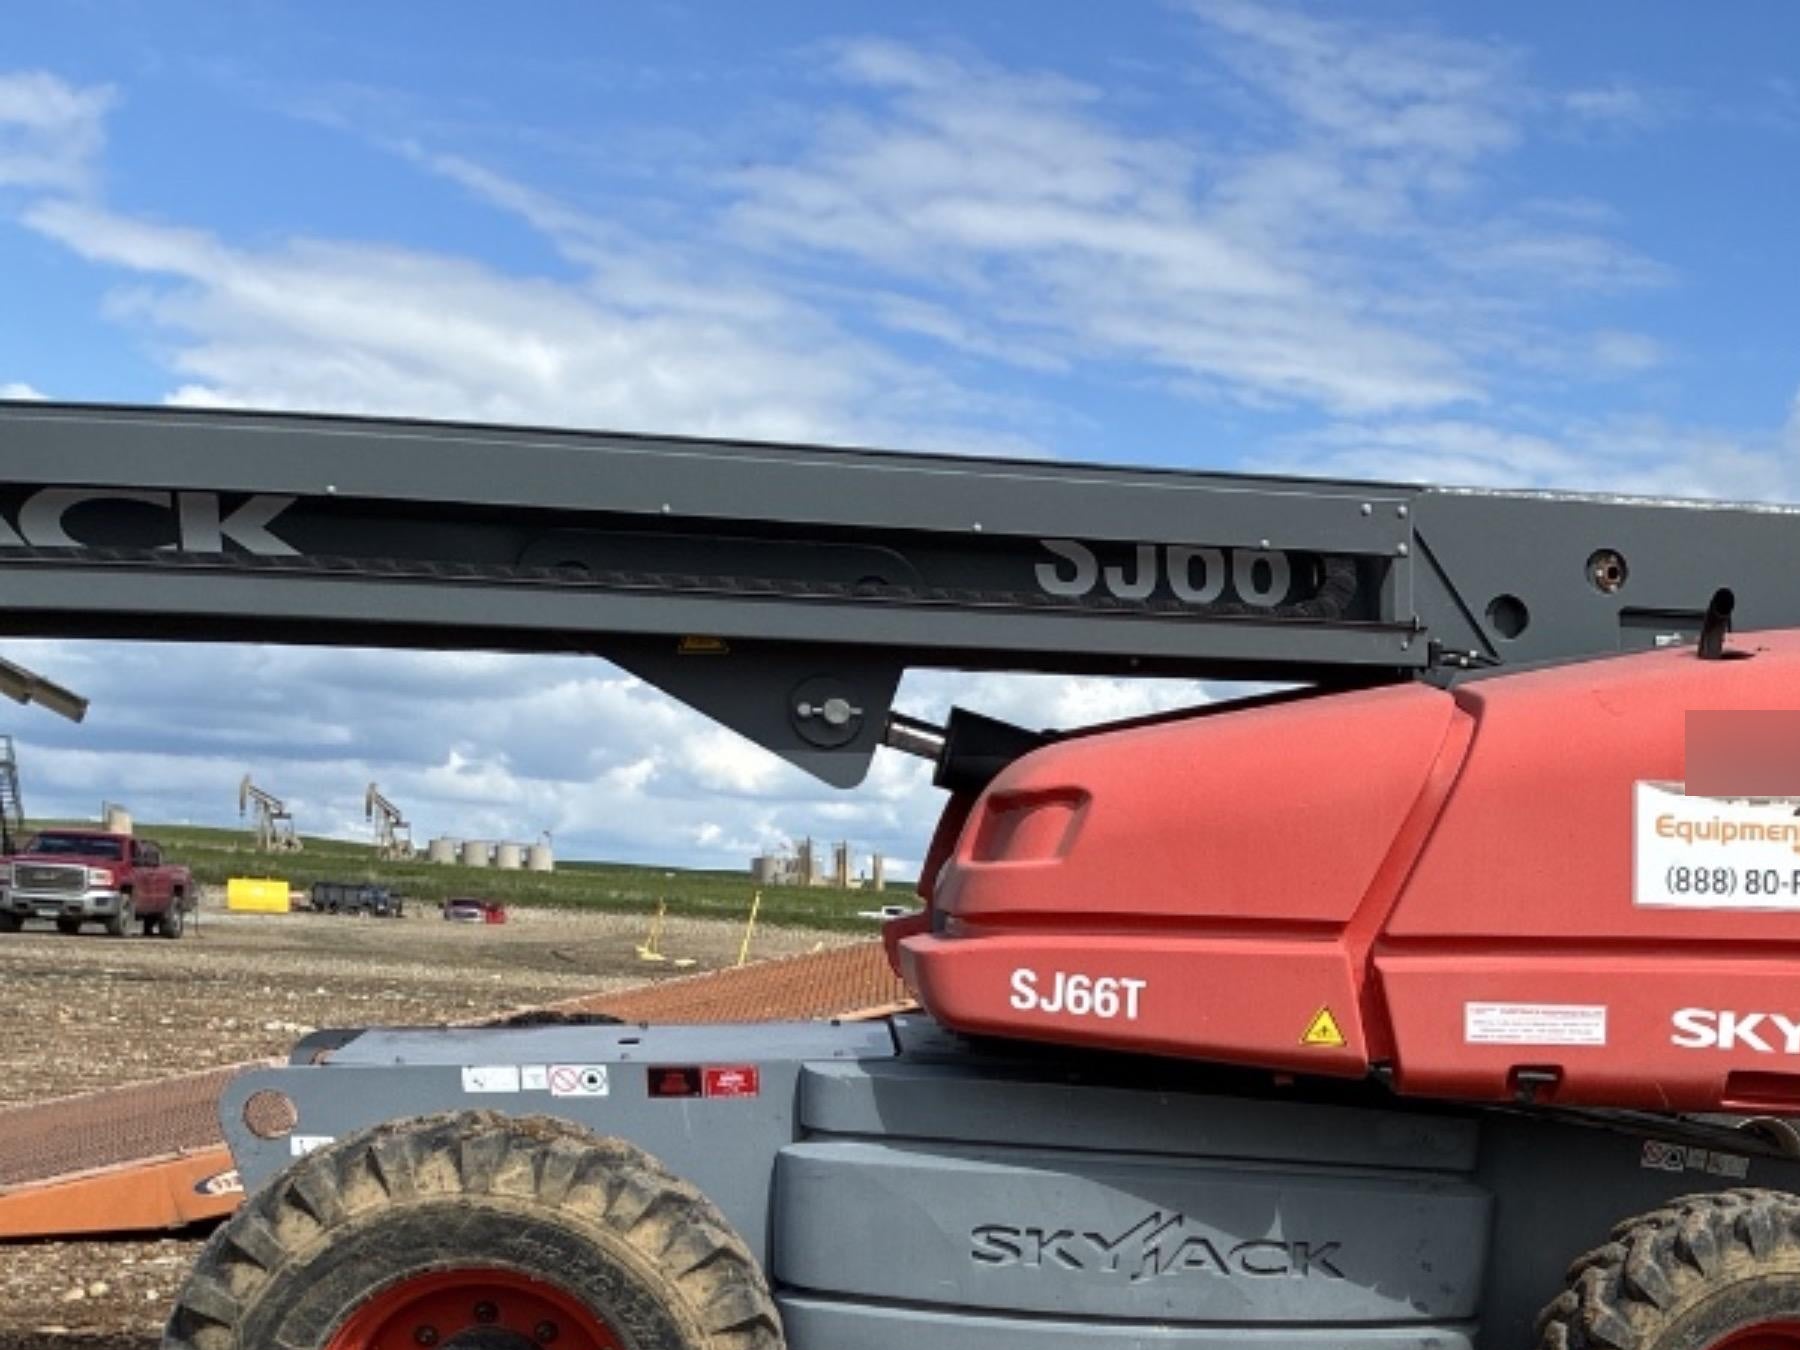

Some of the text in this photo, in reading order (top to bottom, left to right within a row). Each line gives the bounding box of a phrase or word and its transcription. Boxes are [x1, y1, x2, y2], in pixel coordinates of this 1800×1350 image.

[0, 487, 301, 557] CK
[1665, 866, 1738, 897] (888)
[1010, 967, 1147, 1020] SJ66T
[970, 1211, 1347, 1281] SKYJACK
